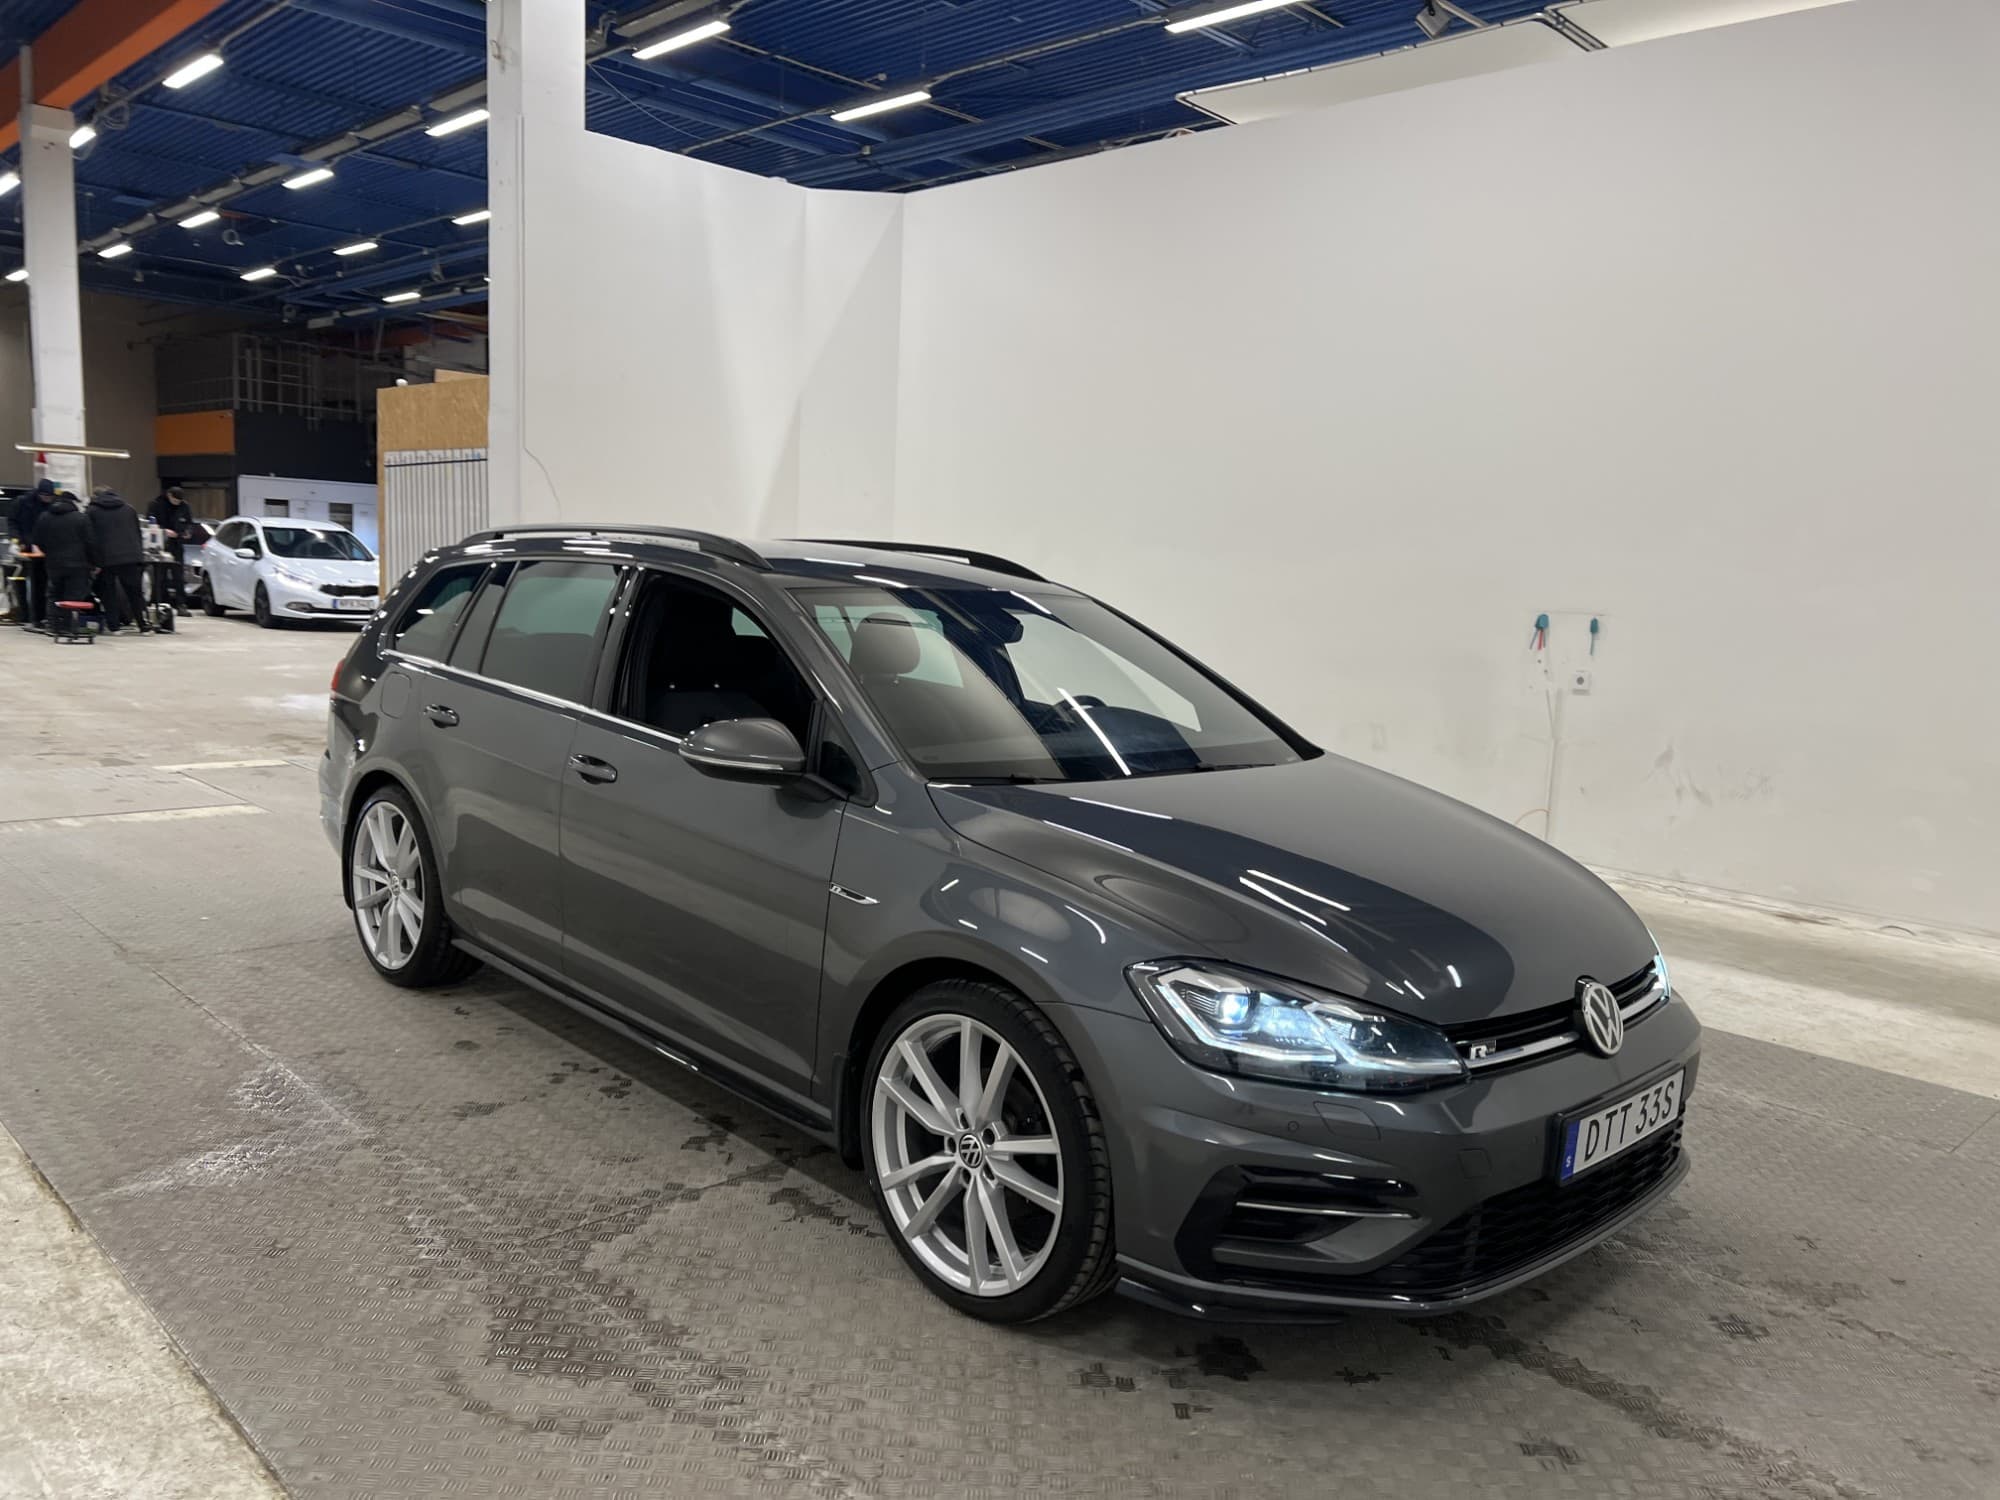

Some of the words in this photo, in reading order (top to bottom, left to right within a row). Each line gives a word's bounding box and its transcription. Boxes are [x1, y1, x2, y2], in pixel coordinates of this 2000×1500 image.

[1584, 1102, 1633, 1162] DTT
[1635, 1080, 1674, 1134] 33S
[1565, 1155, 1572, 1168] S
